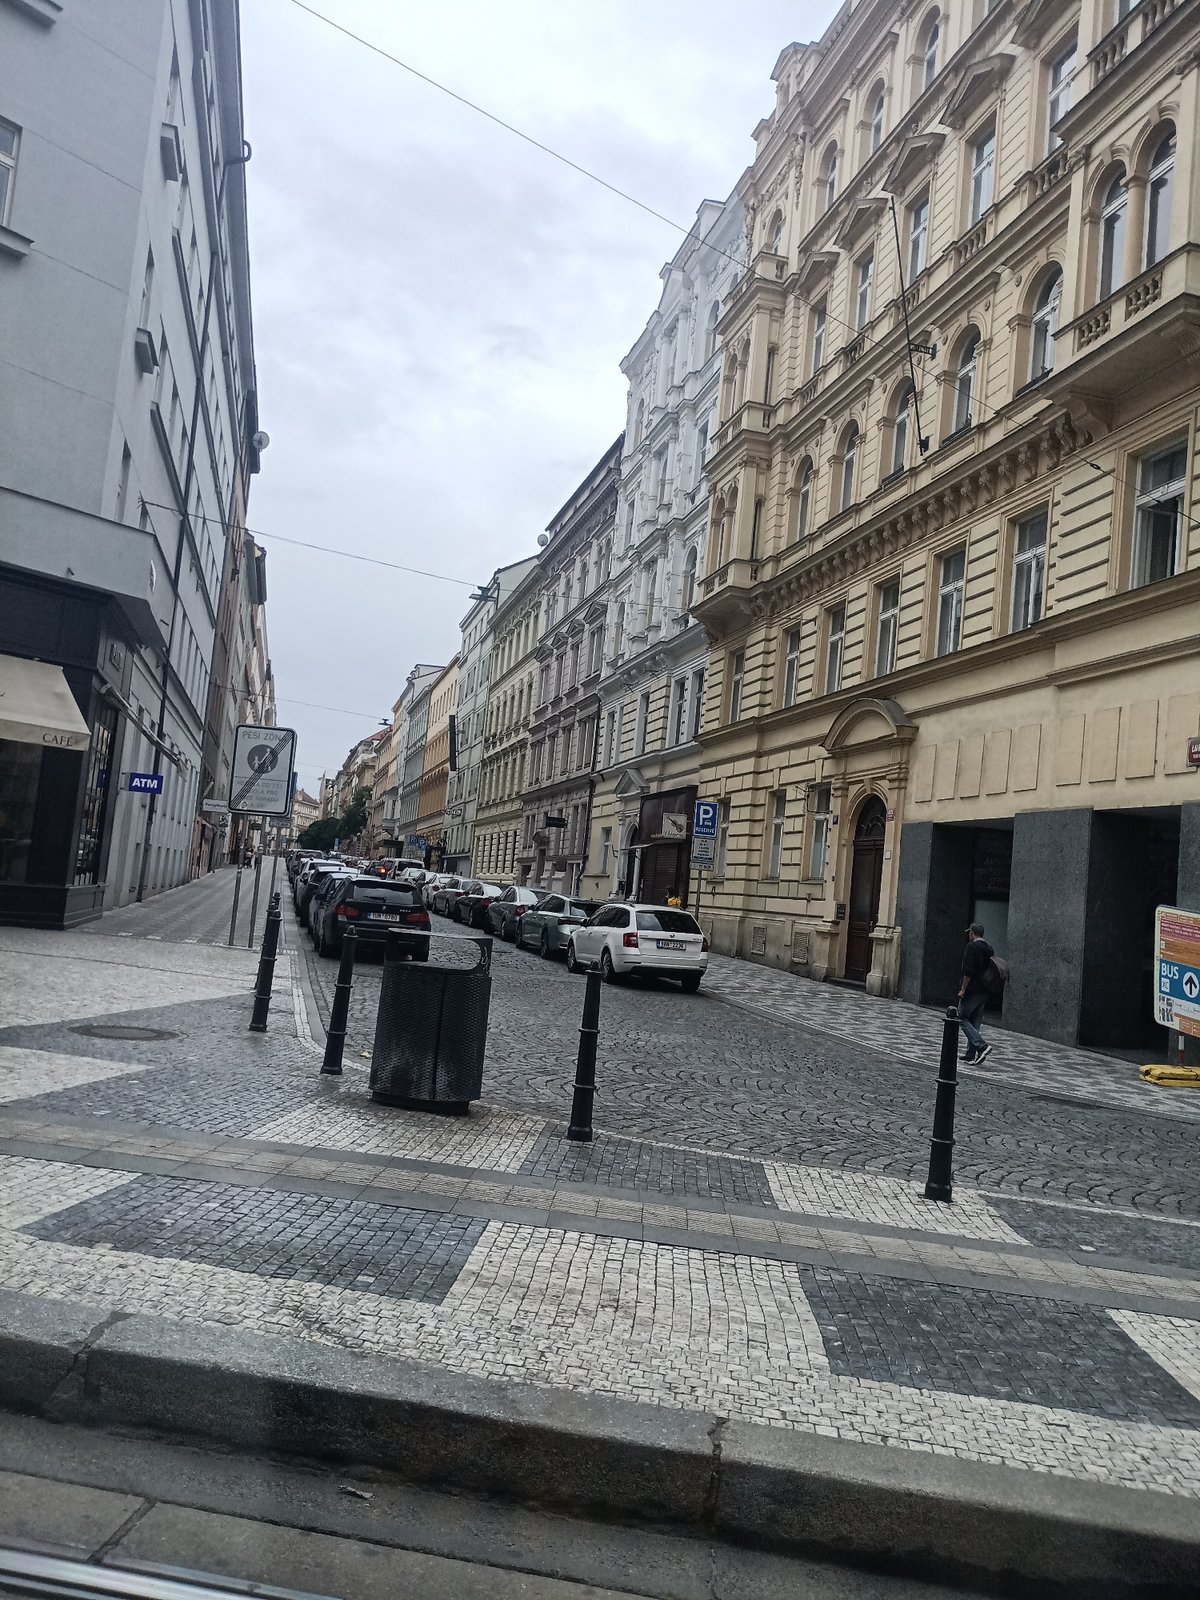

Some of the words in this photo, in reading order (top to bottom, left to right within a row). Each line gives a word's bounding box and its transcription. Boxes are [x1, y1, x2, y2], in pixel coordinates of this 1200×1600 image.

[131, 777, 158, 789] ATM
[699, 805, 714, 826] P
[1161, 962, 1179, 979] BUS
